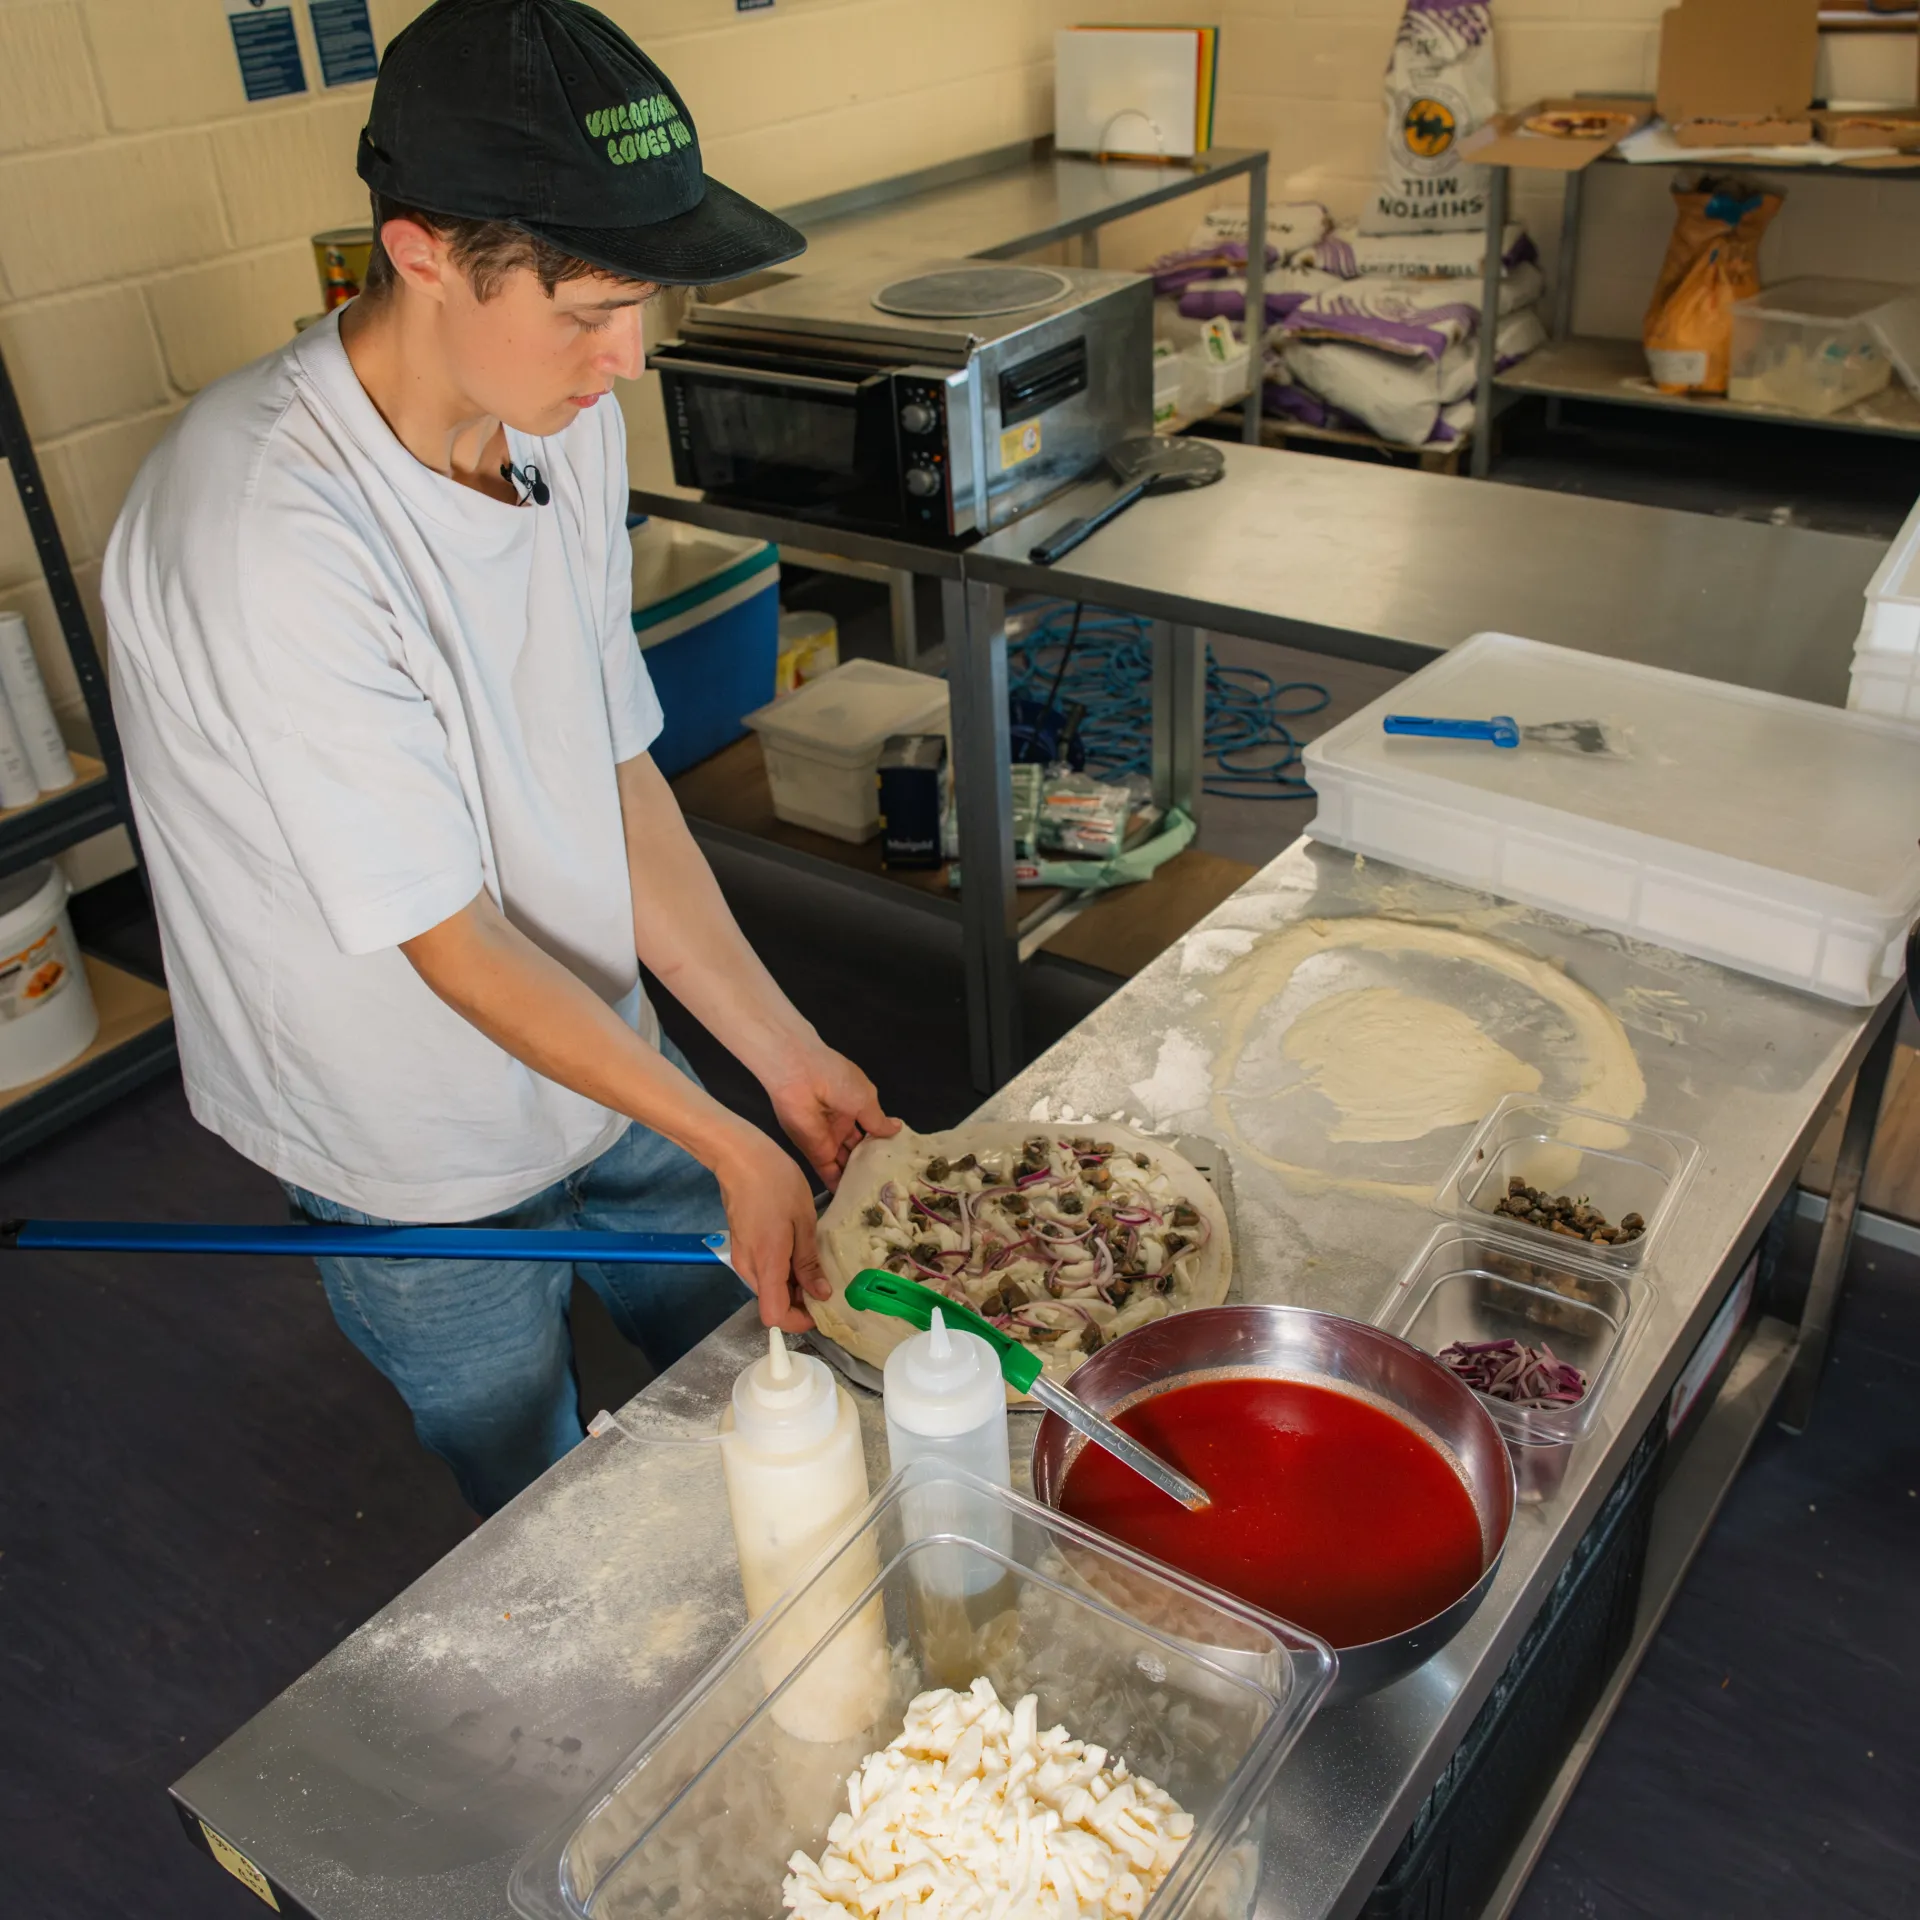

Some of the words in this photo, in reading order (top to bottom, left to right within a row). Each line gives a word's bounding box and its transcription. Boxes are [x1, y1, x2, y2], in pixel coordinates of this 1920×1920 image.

[585, 93, 679, 138] WILDFAR
[607, 126, 671, 165] LOVES
[1401, 177, 1458, 197] MILL
[1378, 196, 1484, 219] SHIPTON
